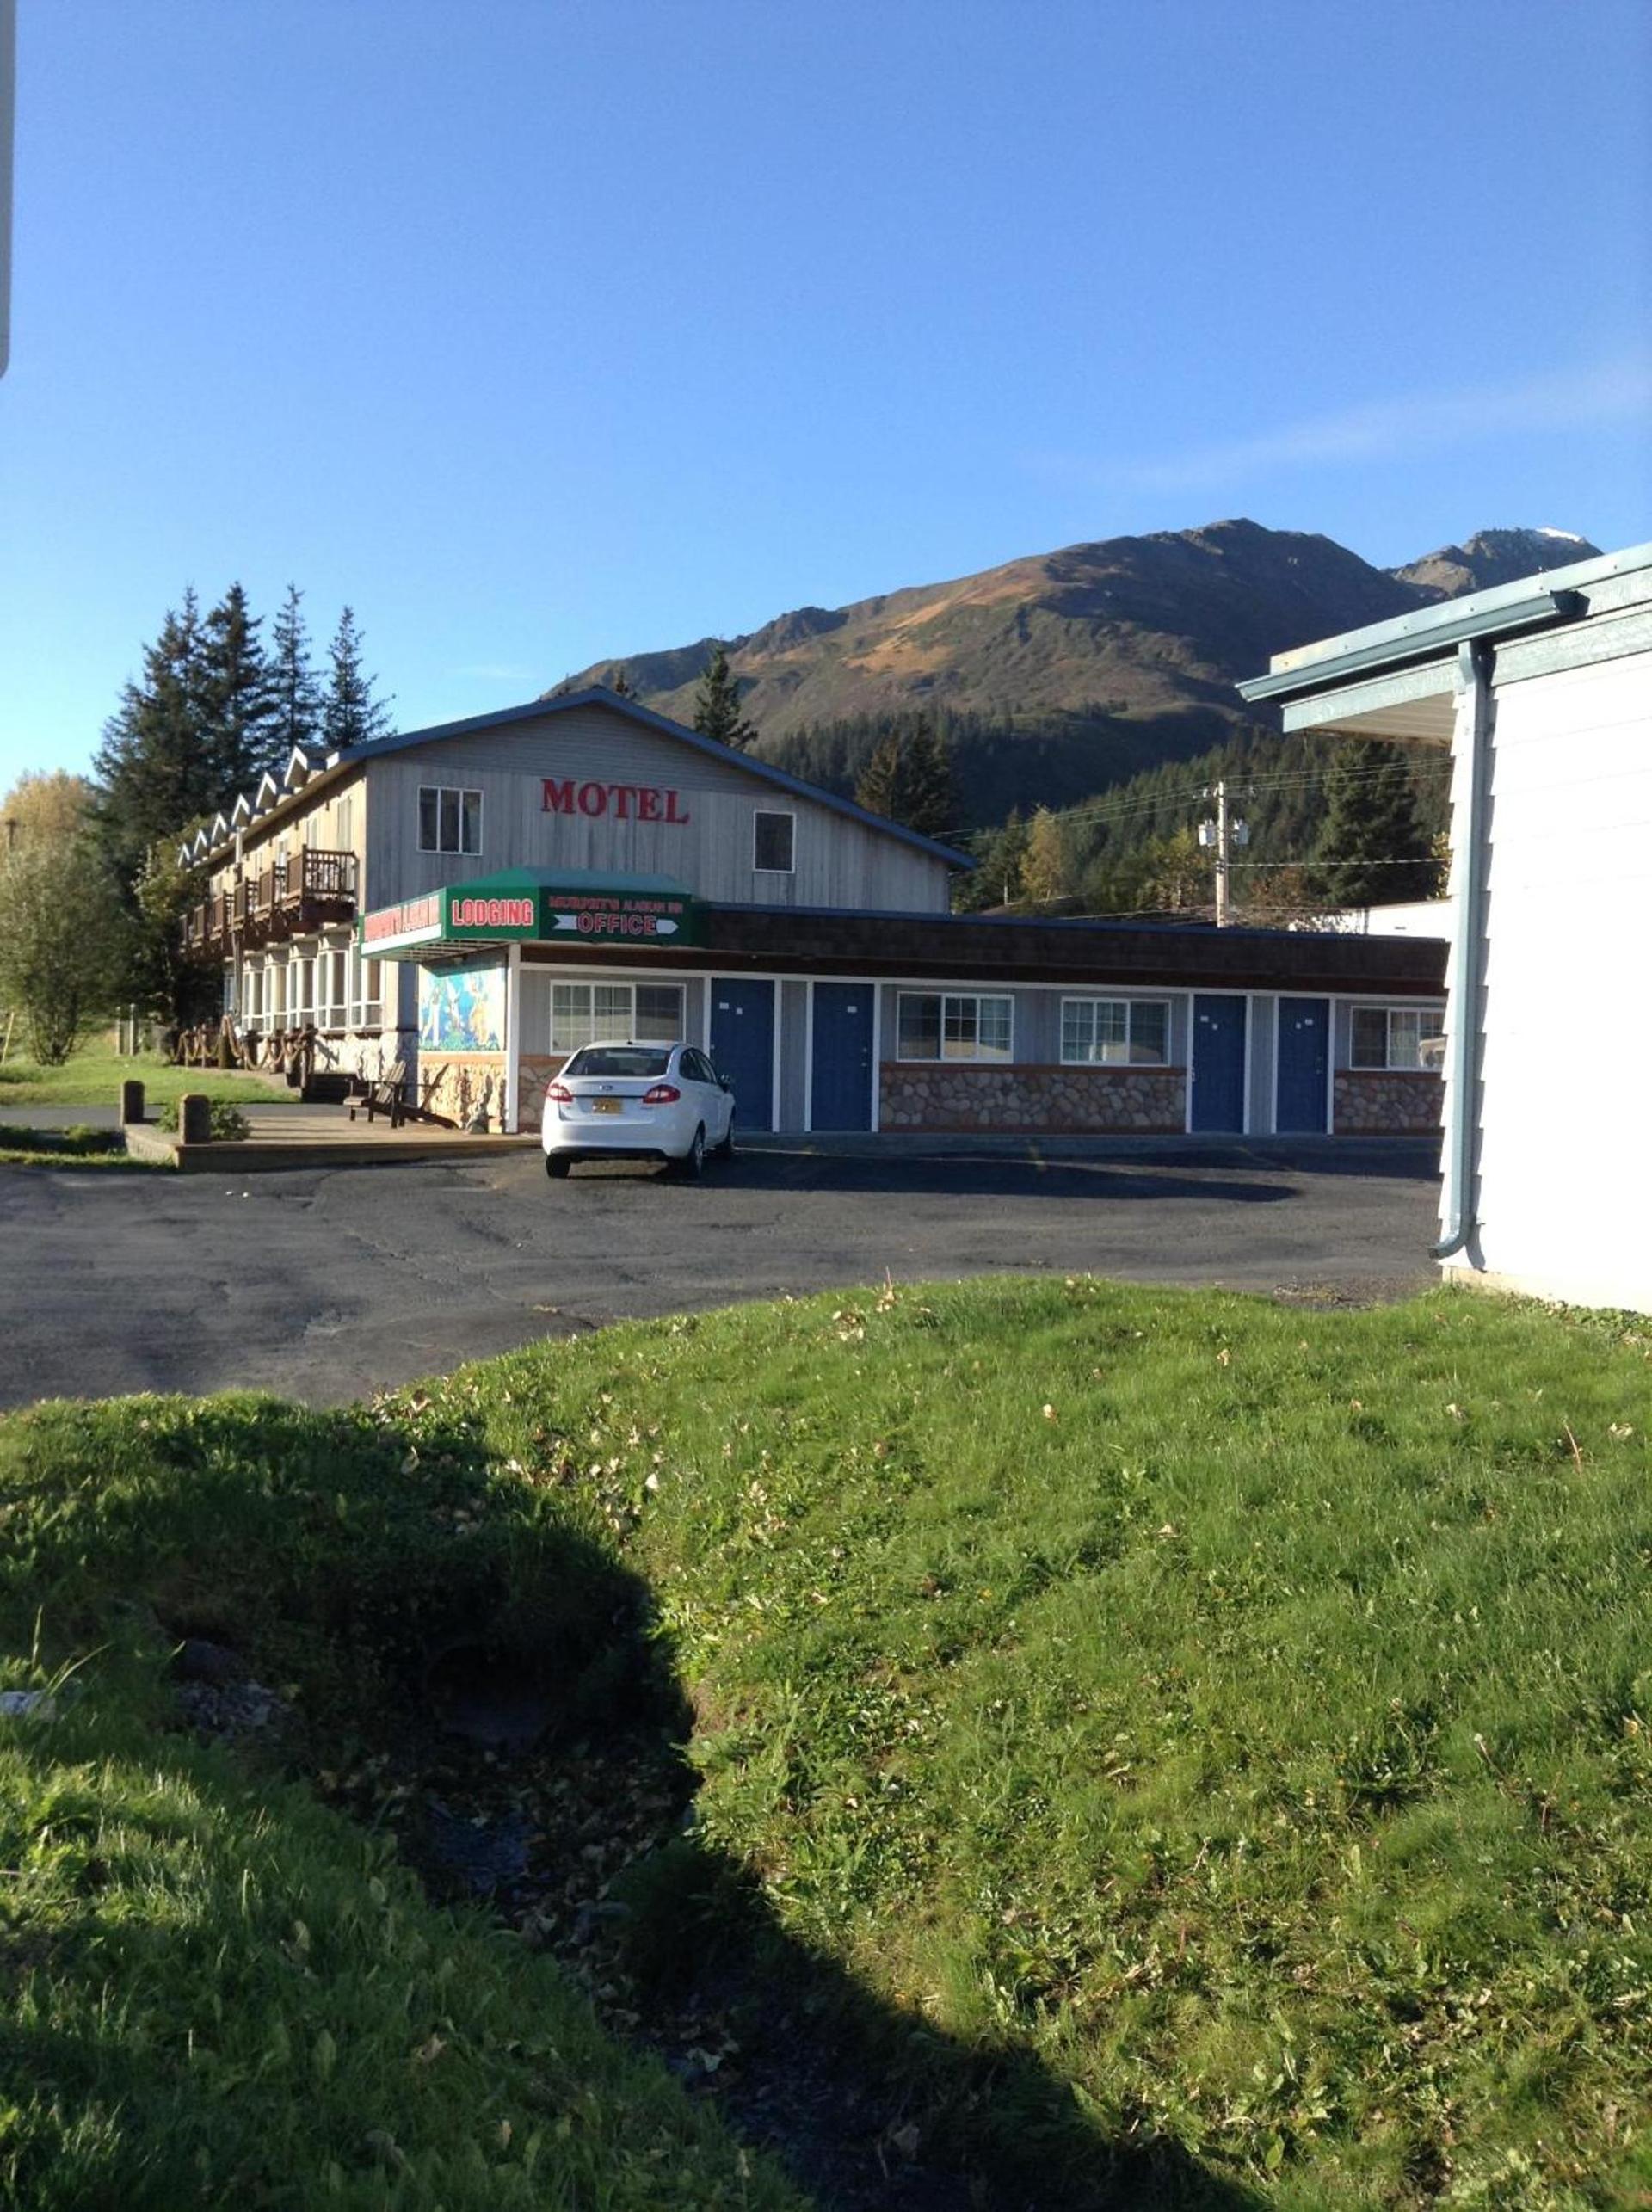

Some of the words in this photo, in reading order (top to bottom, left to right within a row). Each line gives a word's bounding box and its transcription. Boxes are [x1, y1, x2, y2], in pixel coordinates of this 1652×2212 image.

[540, 778, 690, 823] MOTEL
[453, 899, 533, 926] LODGING
[577, 912, 657, 935] OFFICE
